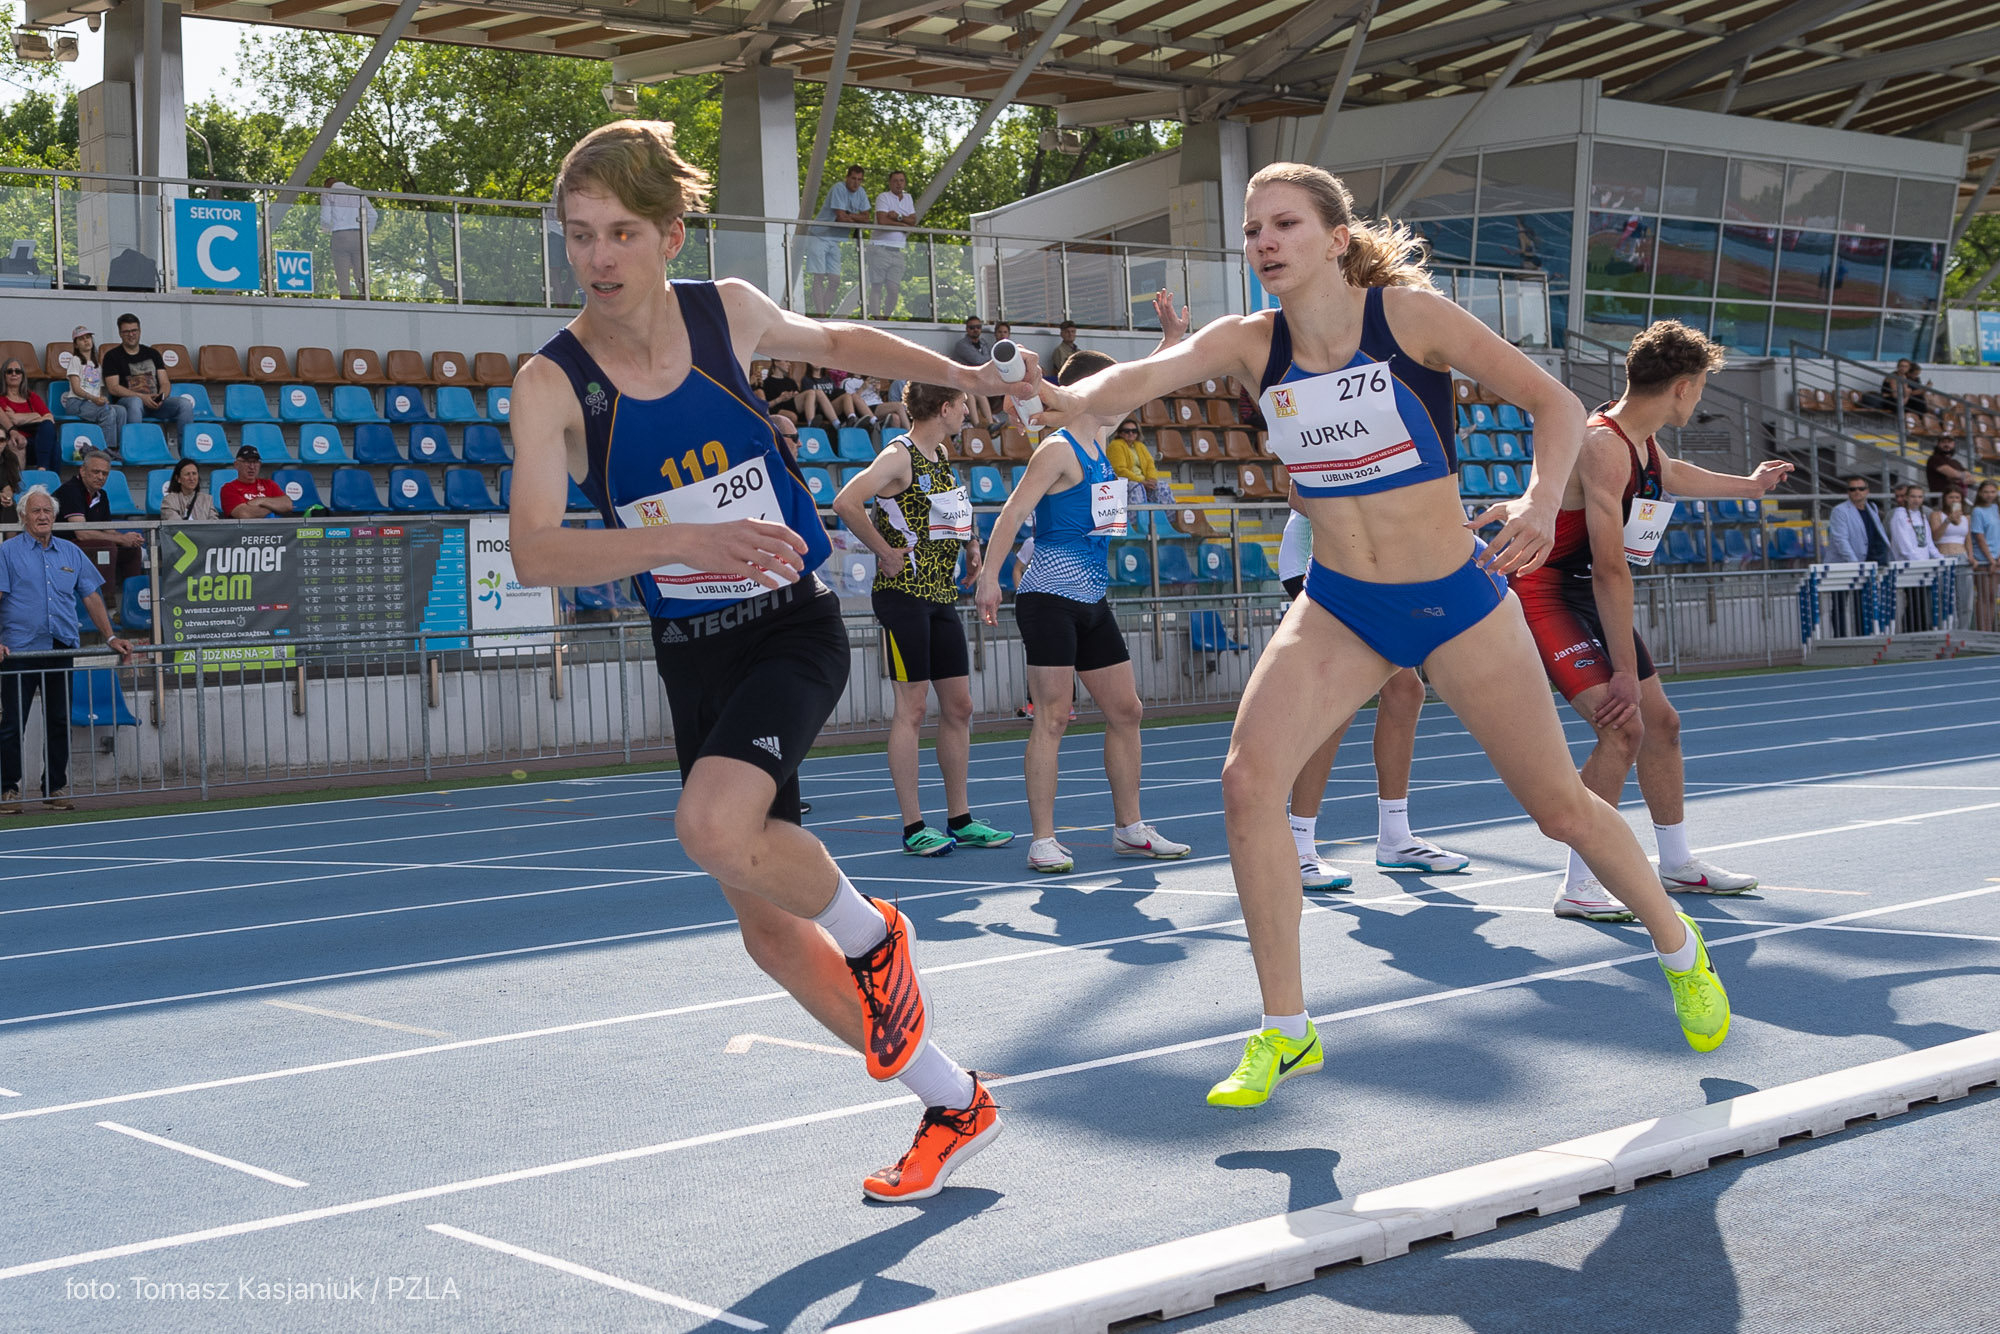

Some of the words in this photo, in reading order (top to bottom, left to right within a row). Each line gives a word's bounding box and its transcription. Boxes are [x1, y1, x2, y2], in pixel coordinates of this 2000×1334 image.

[190, 206, 242, 221] SEKTOR
[197, 224, 240, 282] C
[279, 256, 310, 275] WC
[1336, 370, 1386, 402] 276
[1300, 420, 1370, 448] JURKA
[1322, 474, 1354, 482] LUBLIN
[1354, 466, 1380, 478] 2024
[712, 467, 764, 508] 280
[242, 536, 283, 545] PERFECT
[204, 546, 286, 574] runner
[187, 574, 252, 601] team
[696, 585, 732, 594] LUBLIN
[732, 582, 761, 593] 2024
[688, 586, 794, 638] TECHFIT
[661, 634, 688, 644] adidas
[184, 648, 221, 661] ZNJDŹ
[224, 649, 242, 659] NAS
[245, 648, 258, 658] NA
[1554, 642, 1589, 661] Janas
[752, 739, 782, 760] adidas
[938, 1136, 958, 1162] new
